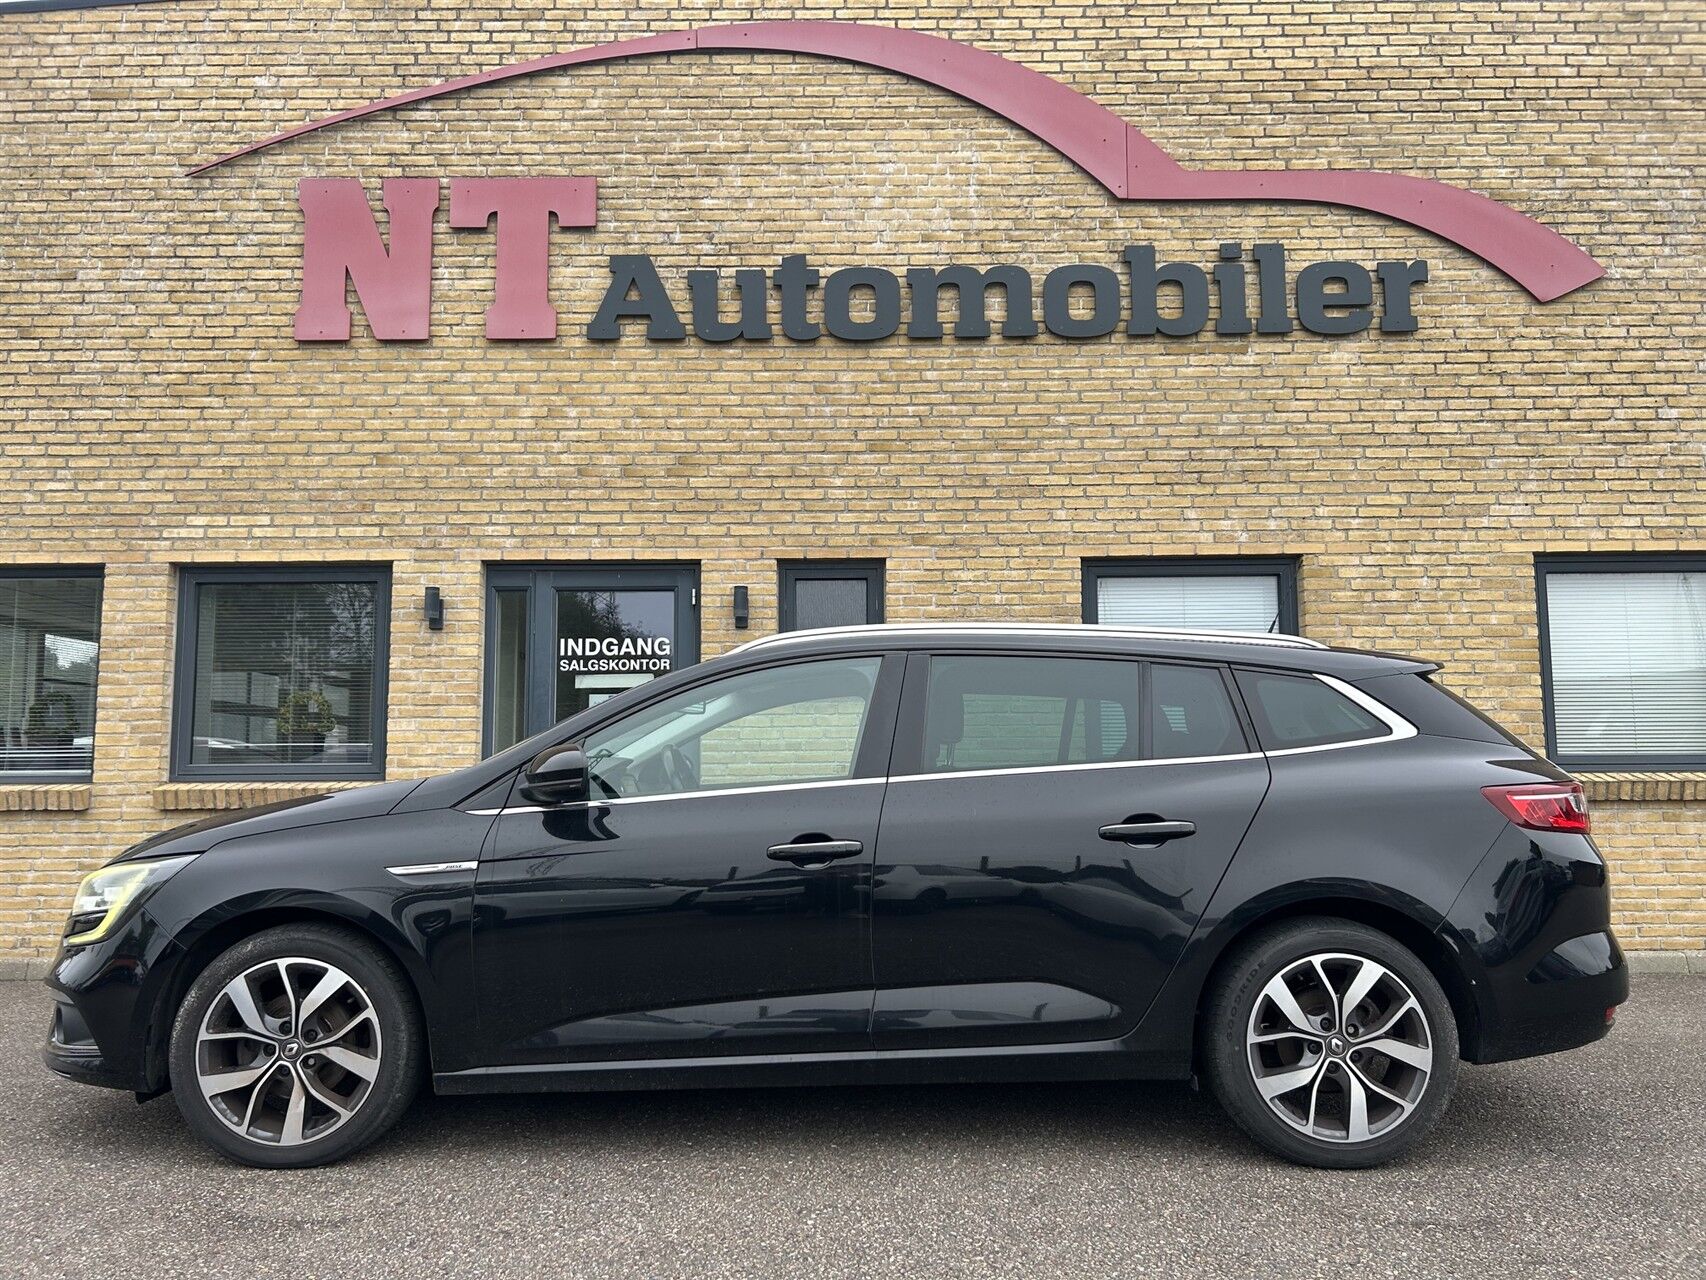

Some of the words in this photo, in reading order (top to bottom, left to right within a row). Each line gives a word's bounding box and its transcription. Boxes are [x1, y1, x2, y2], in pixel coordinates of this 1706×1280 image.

[294, 177, 598, 341] NT
[587, 242, 1429, 342] Automobiler
[559, 637, 671, 656] INDGANG
[559, 658, 671, 671] SALGSKONTOR
